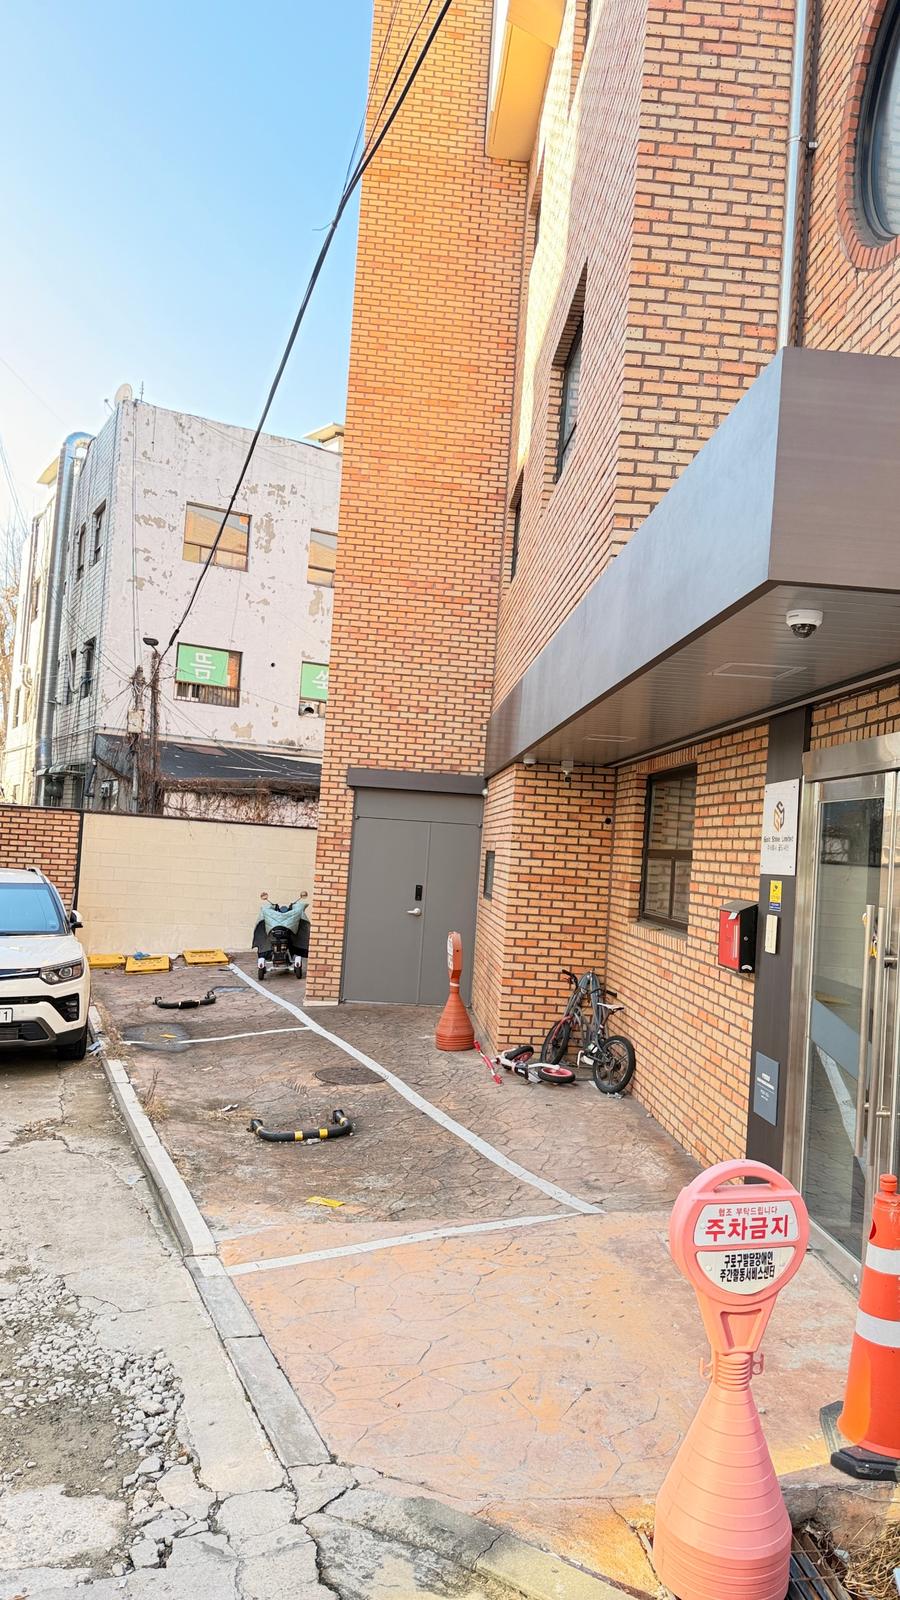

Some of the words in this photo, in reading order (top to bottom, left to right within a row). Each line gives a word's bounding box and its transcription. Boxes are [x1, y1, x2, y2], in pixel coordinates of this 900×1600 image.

[718, 1207, 733, 1217] 협조
[736, 1205, 778, 1216] 부탁드립니다
[705, 1214, 789, 1242] 주차금지
[724, 1251, 773, 1268] 구로구발달장애인
[720, 1265, 776, 1283] 주간활동서비스센터
